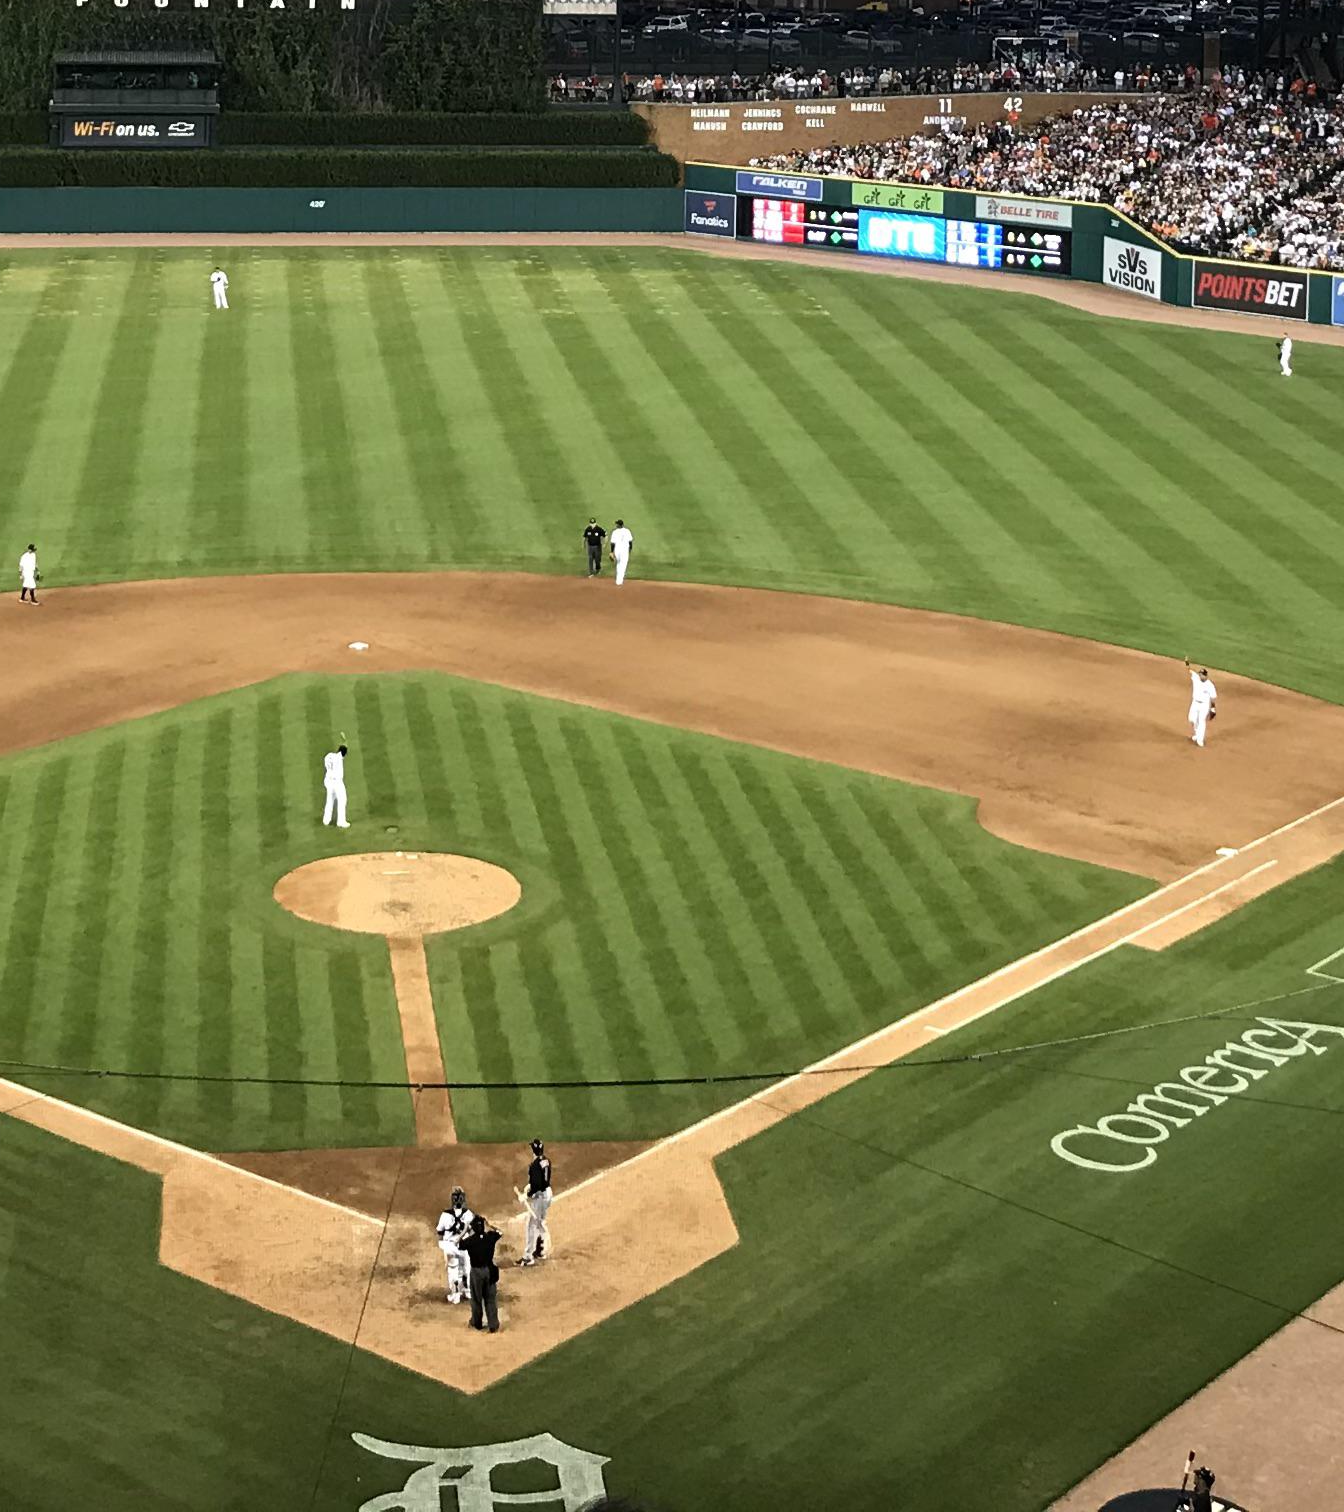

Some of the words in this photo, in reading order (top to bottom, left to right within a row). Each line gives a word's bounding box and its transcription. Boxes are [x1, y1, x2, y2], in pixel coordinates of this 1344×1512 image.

[938, 98, 952, 113] 11
[1003, 97, 1023, 113] 42
[74, 121, 115, 136] Wi-Fi
[115, 124, 135, 136] on
[137, 124, 160, 136] us.
[752, 176, 807, 190] FALKEN
[1000, 205, 1032, 218] BELLE
[1035, 209, 1059, 220] TIRE
[691, 213, 729, 229] Fanatics
[1108, 267, 1155, 295] VISION
[1197, 272, 1304, 308] POINTSBET
